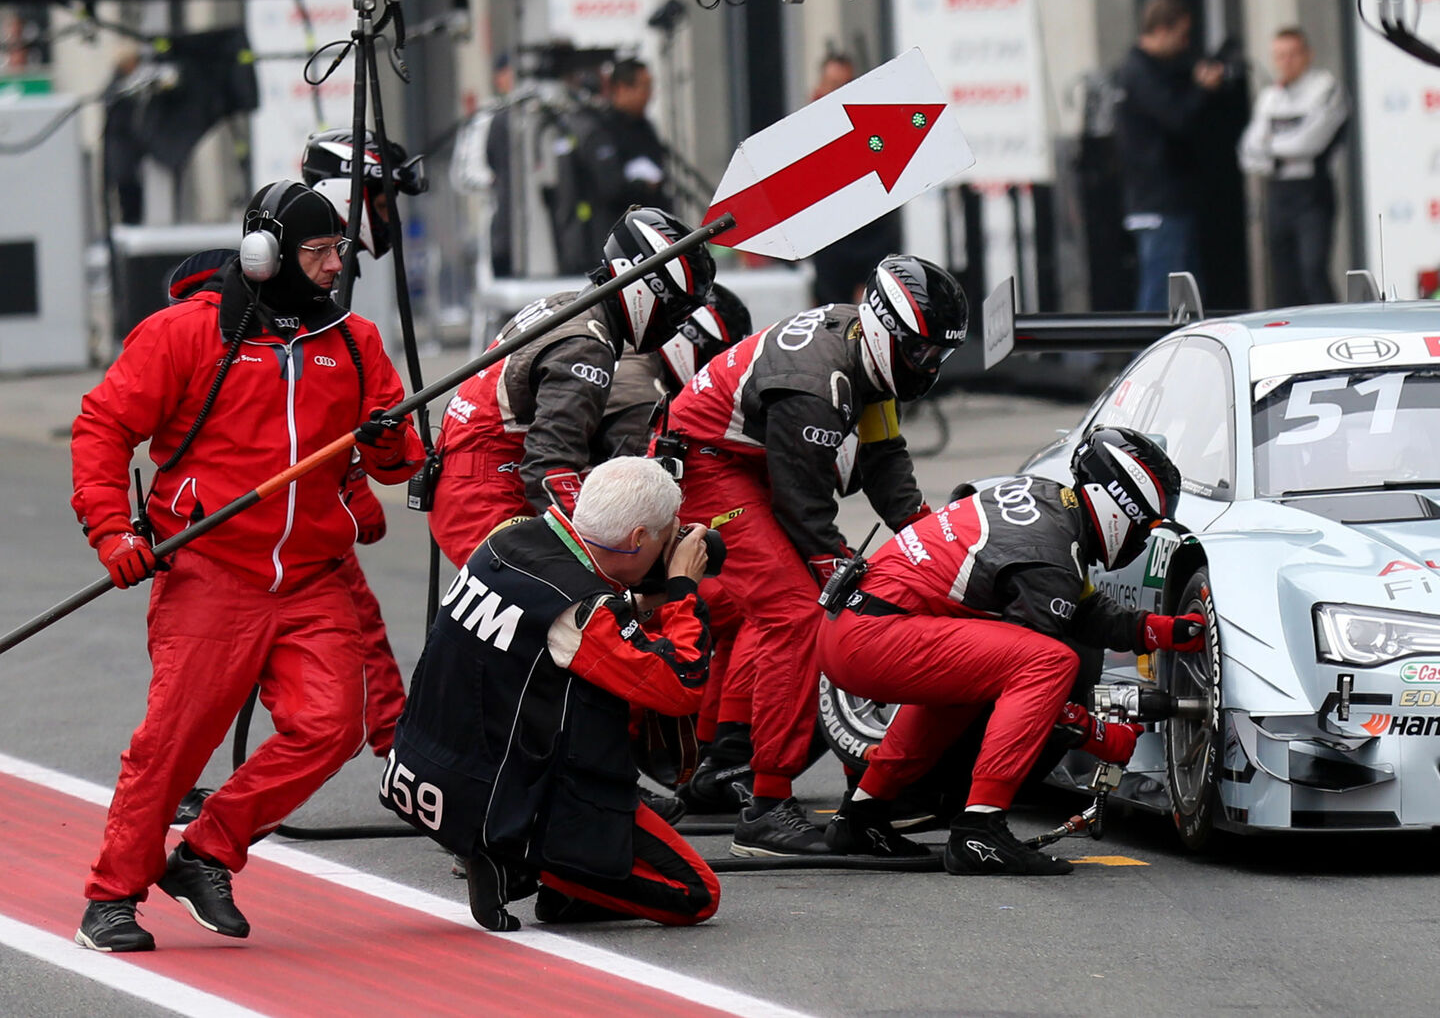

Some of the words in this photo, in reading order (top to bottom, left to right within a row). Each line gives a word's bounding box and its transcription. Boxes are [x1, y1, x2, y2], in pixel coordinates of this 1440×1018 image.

[869, 289, 909, 342] uvex
[945, 329, 966, 340] uve
[1275, 371, 1413, 446] 51
[1107, 480, 1148, 525] uvex
[441, 564, 525, 652] DTM
